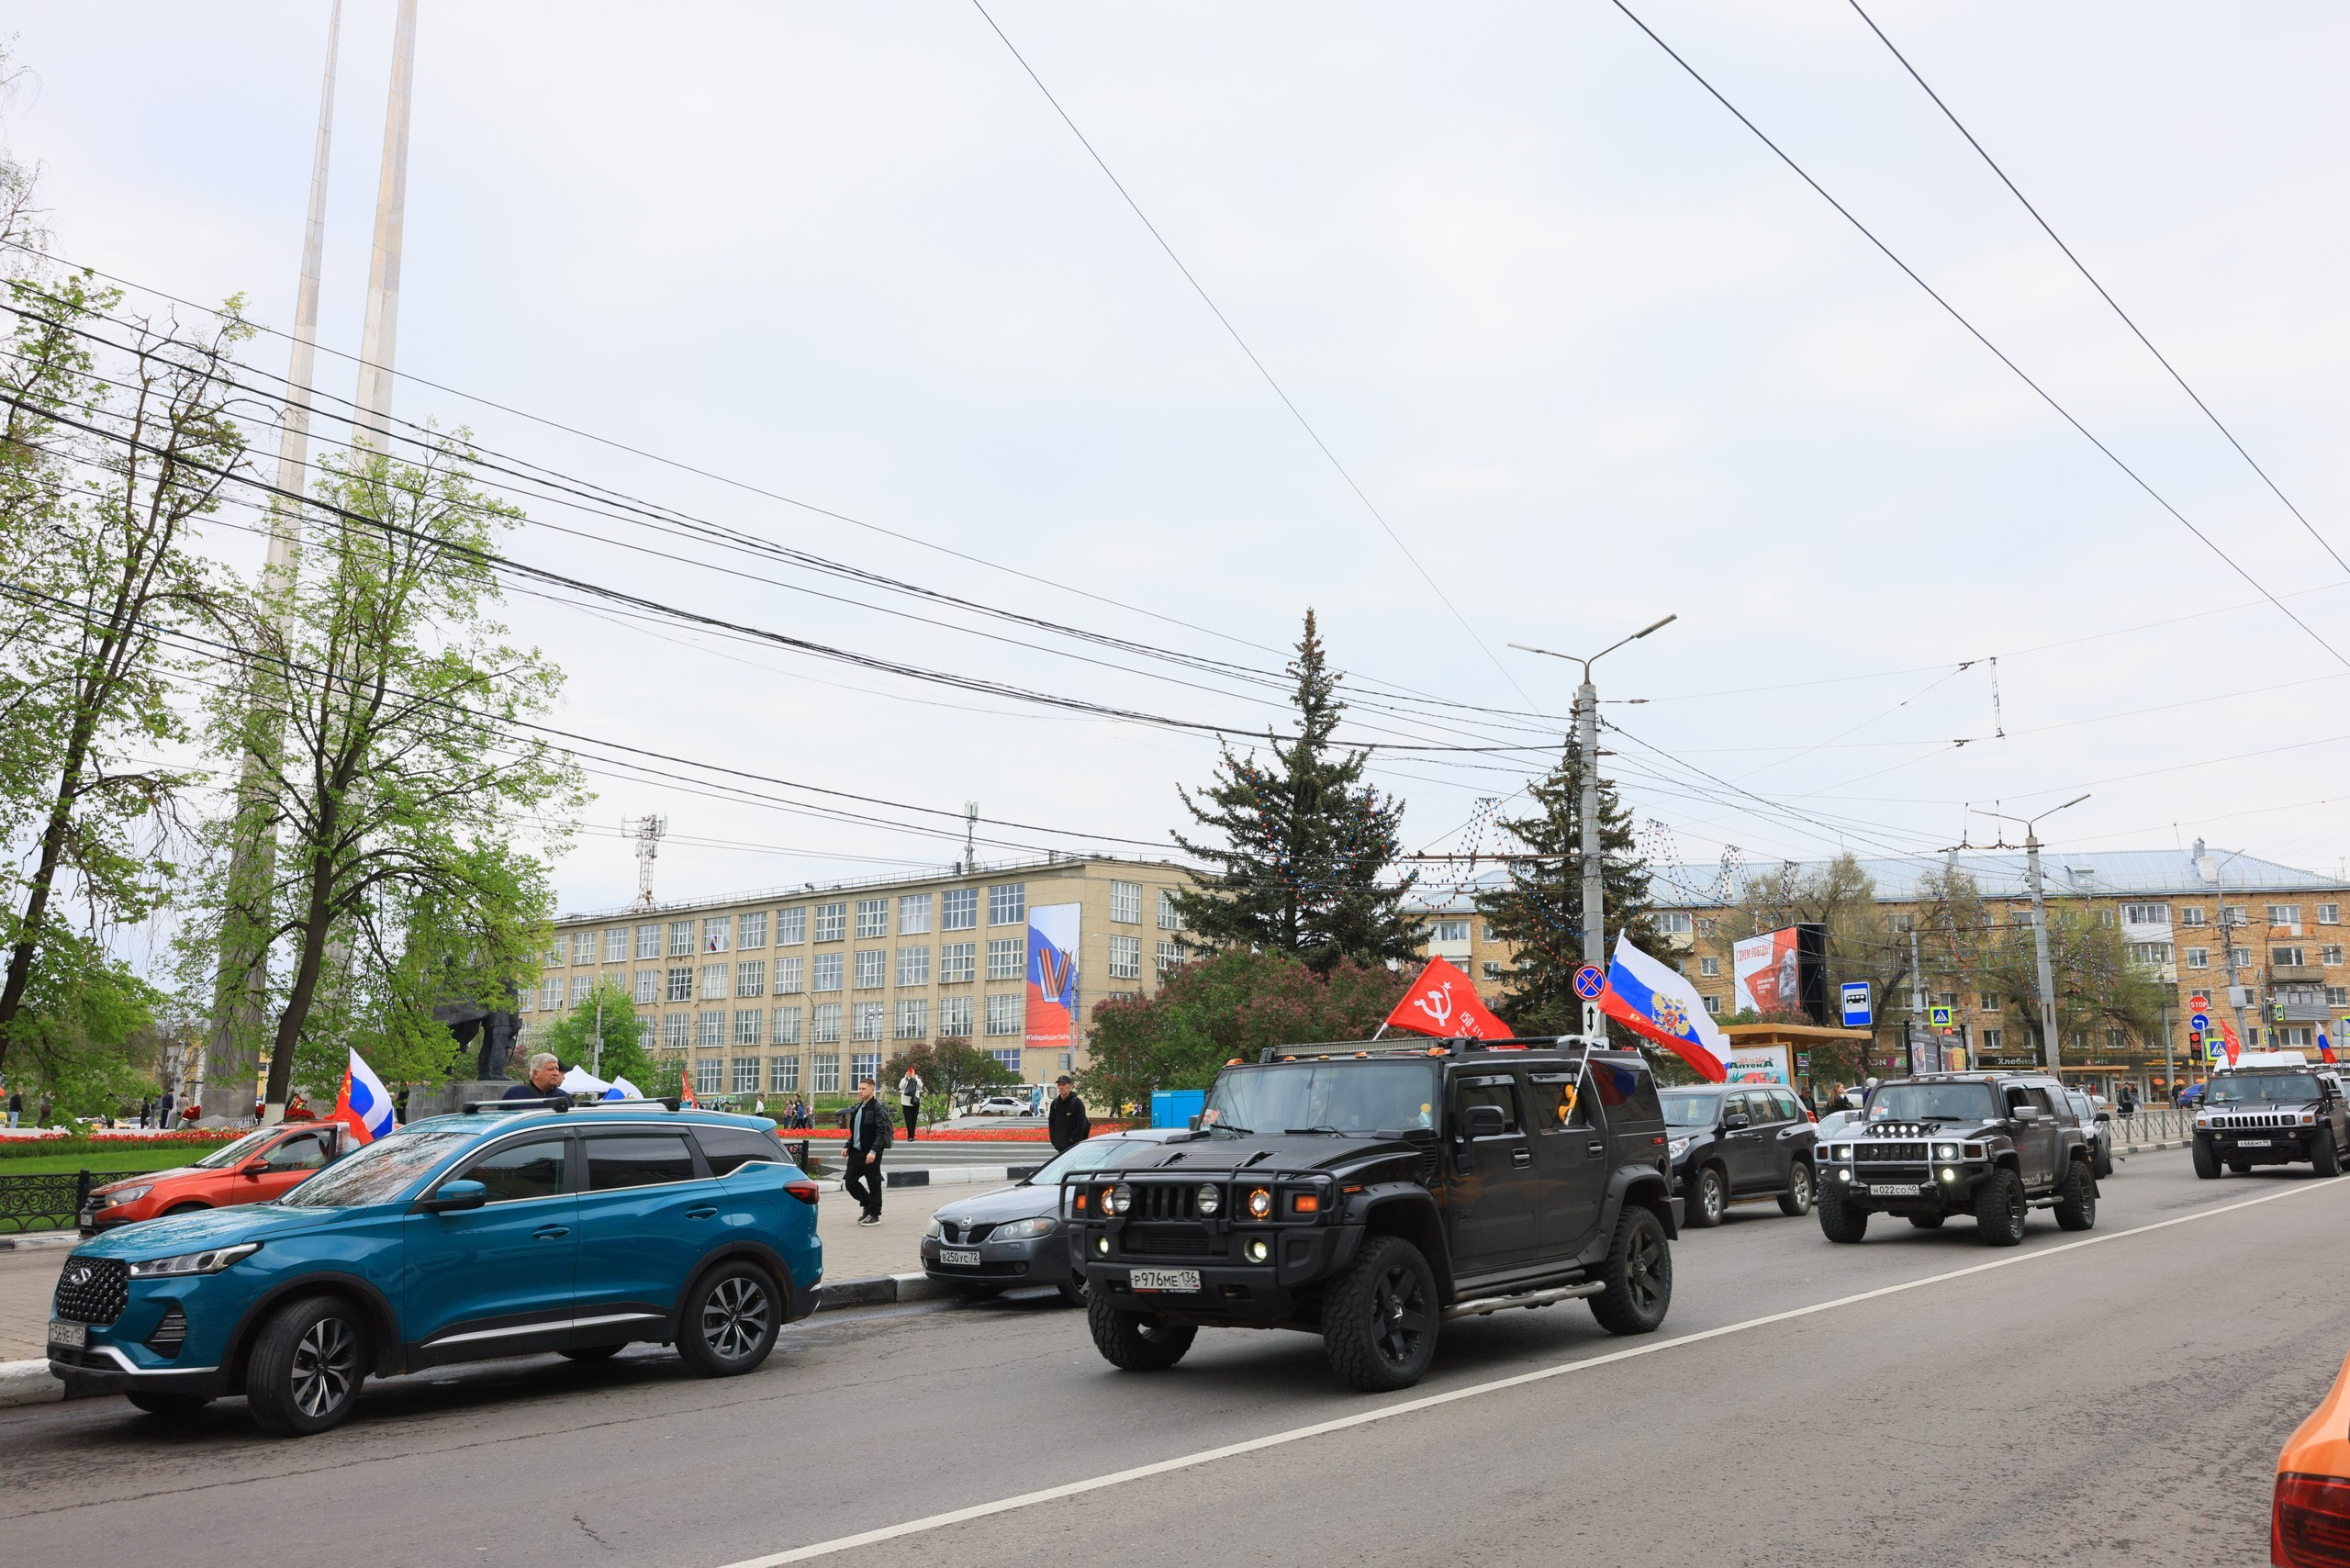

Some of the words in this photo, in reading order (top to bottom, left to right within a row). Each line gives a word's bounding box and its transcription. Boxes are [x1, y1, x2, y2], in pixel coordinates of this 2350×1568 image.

[1460, 1011, 1475, 1027] 150
[1874, 1185, 1907, 1194] Н022СО
[942, 1251, 968, 1263] В250УС
[969, 1252, 978, 1261] 72
[1134, 1272, 1179, 1287] Р976МЕ
[1180, 1271, 1197, 1283] 136
